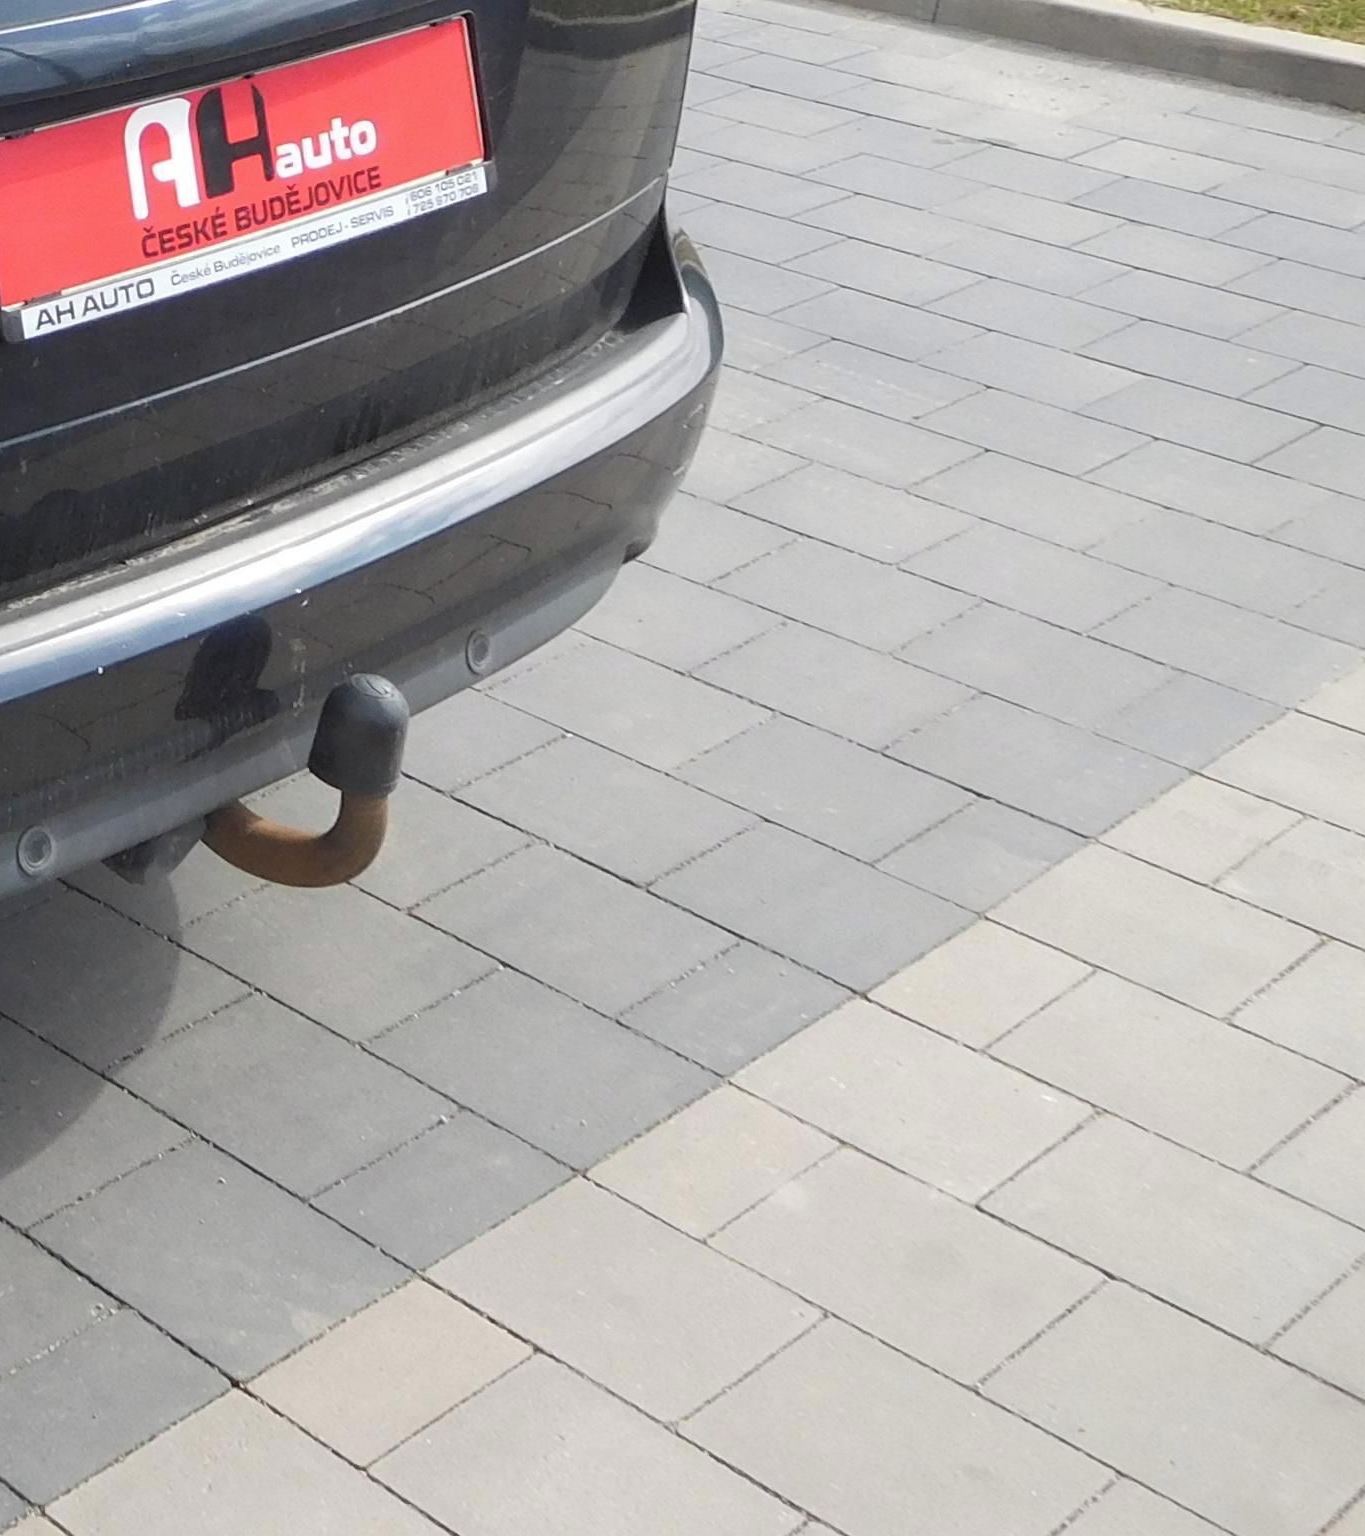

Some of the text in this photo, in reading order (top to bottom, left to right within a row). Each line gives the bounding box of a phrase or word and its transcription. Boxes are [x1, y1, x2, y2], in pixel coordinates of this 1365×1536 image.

[141, 166, 383, 259] ČESKÉ BUDĚJOVICE
[413, 199, 434, 214] 725
[35, 300, 76, 331] AH
[81, 278, 155, 317] AUTO
[213, 243, 281, 275] Budějovice
